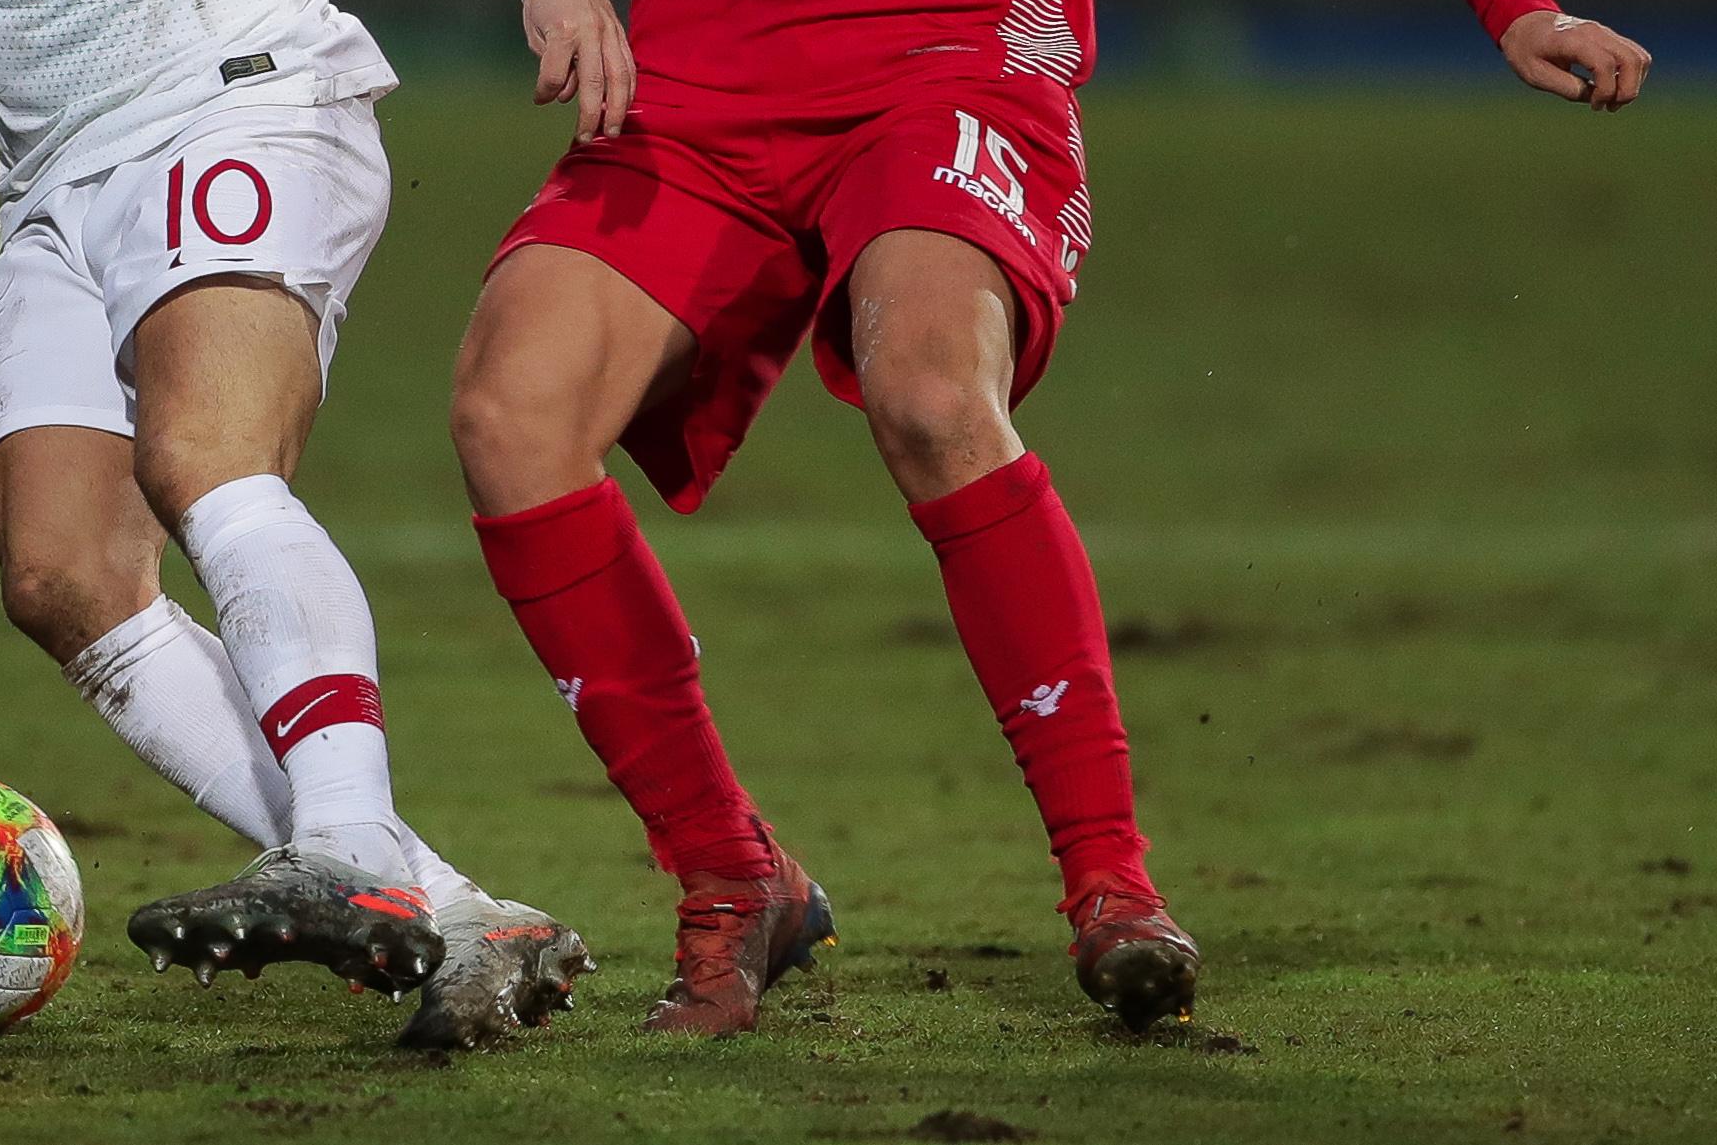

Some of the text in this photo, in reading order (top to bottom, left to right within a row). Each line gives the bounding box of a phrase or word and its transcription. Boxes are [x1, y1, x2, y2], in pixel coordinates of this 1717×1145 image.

[166, 156, 273, 252] 10
[932, 166, 1037, 247] macron
[954, 109, 1029, 216] 15
